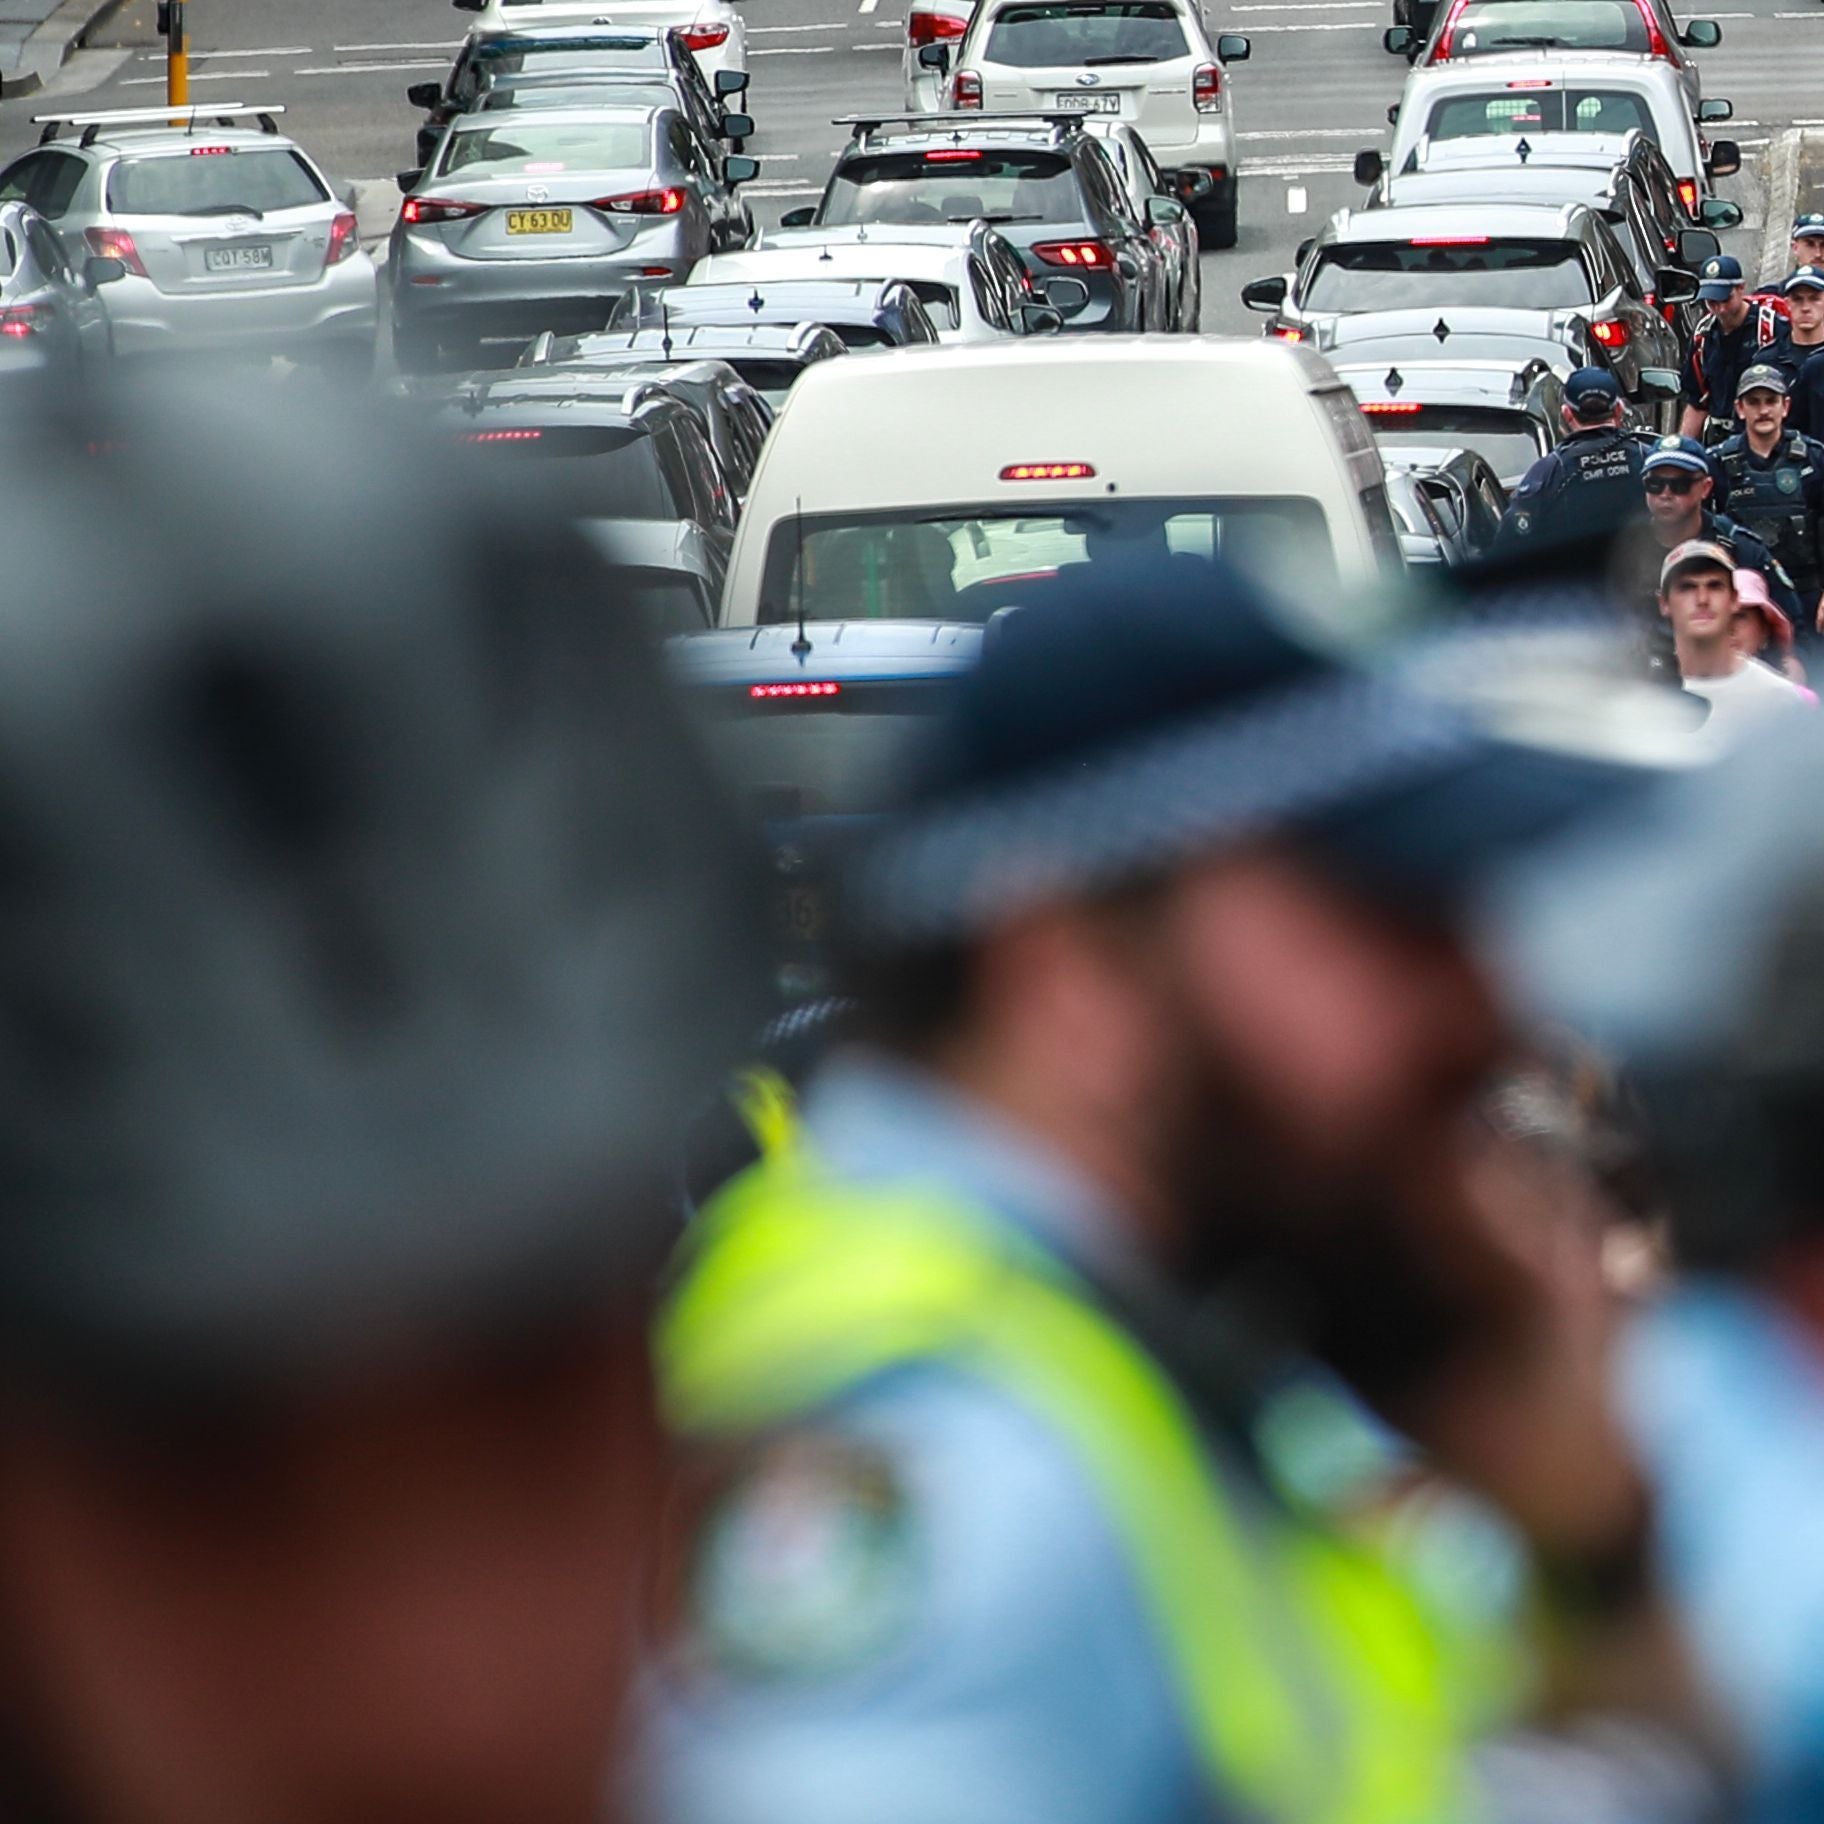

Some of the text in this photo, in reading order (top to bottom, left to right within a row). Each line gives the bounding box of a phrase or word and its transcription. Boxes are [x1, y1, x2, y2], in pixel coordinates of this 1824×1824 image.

[508, 209, 571, 229] CY 63 DU
[1579, 449, 1628, 468] POLICE
